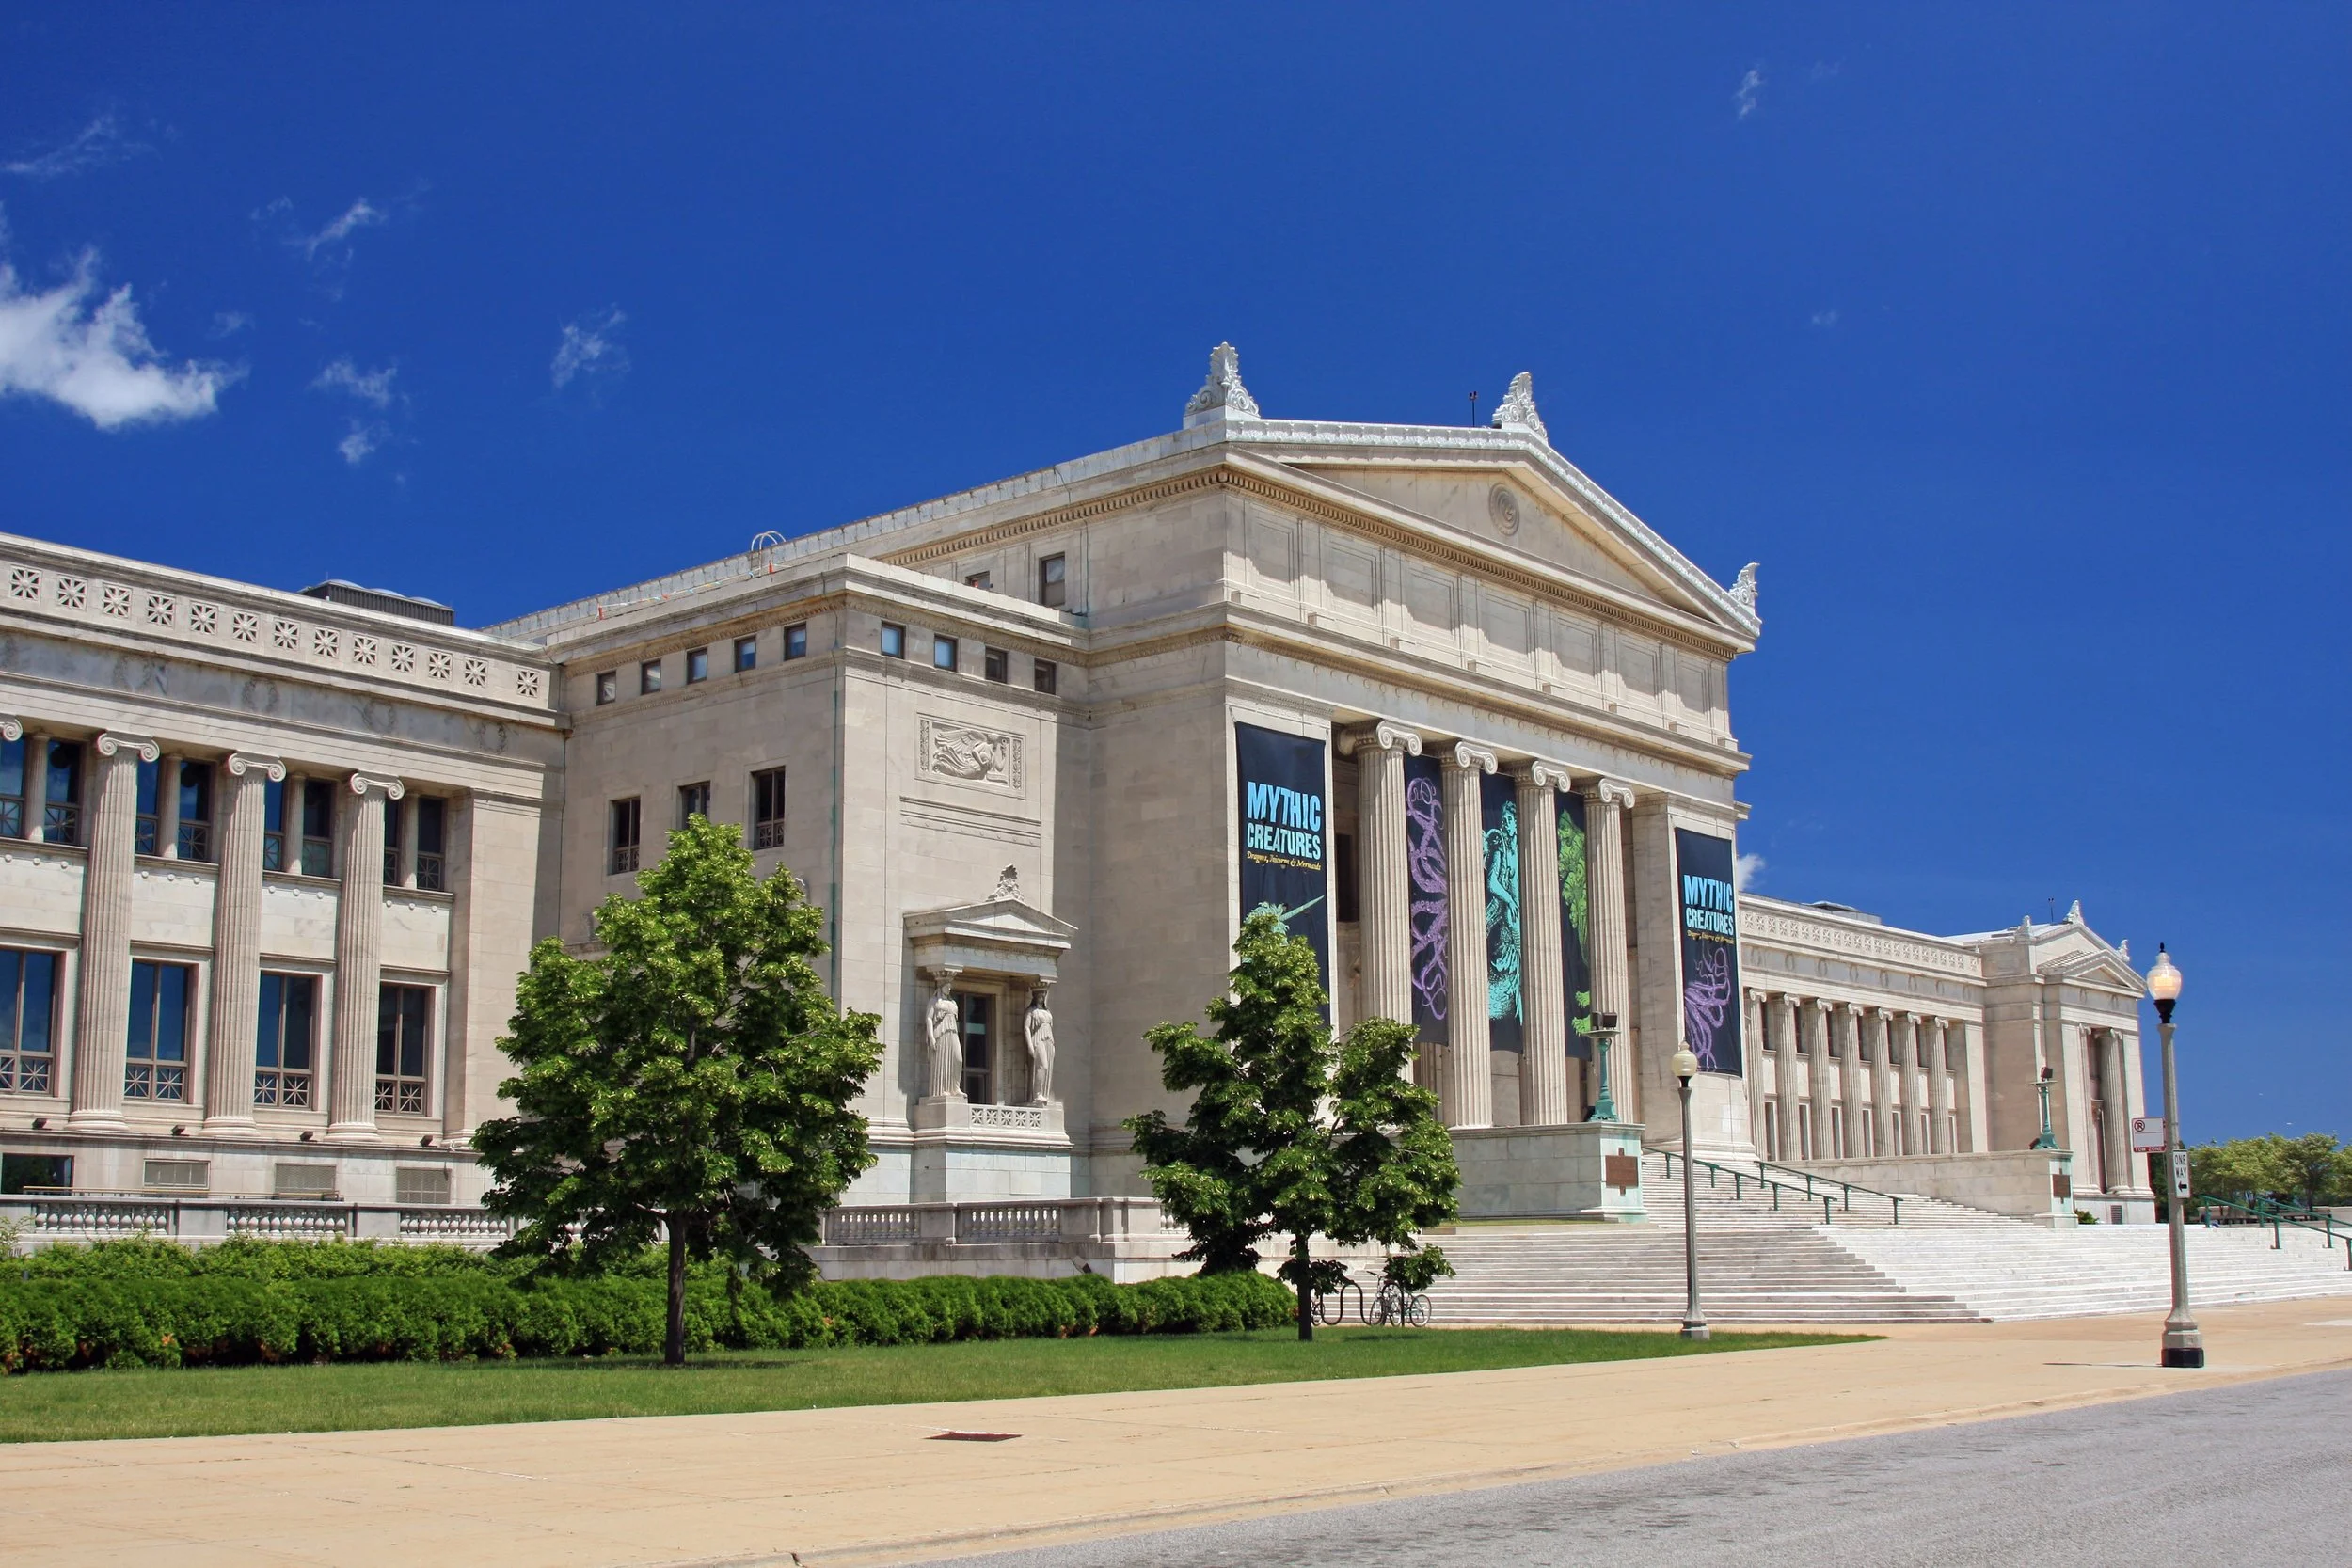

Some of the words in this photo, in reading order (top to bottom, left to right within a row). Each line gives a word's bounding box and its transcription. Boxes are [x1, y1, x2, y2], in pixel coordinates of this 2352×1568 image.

[1248, 781, 1321, 832] MYTHIC
[1247, 822, 1322, 860] CREATURES
[1684, 874, 1733, 913] MYTHIC
[1686, 907, 1734, 936] CREATURES
[2174, 1154, 2186, 1165] ONE
[2175, 1166, 2187, 1178] WAY
